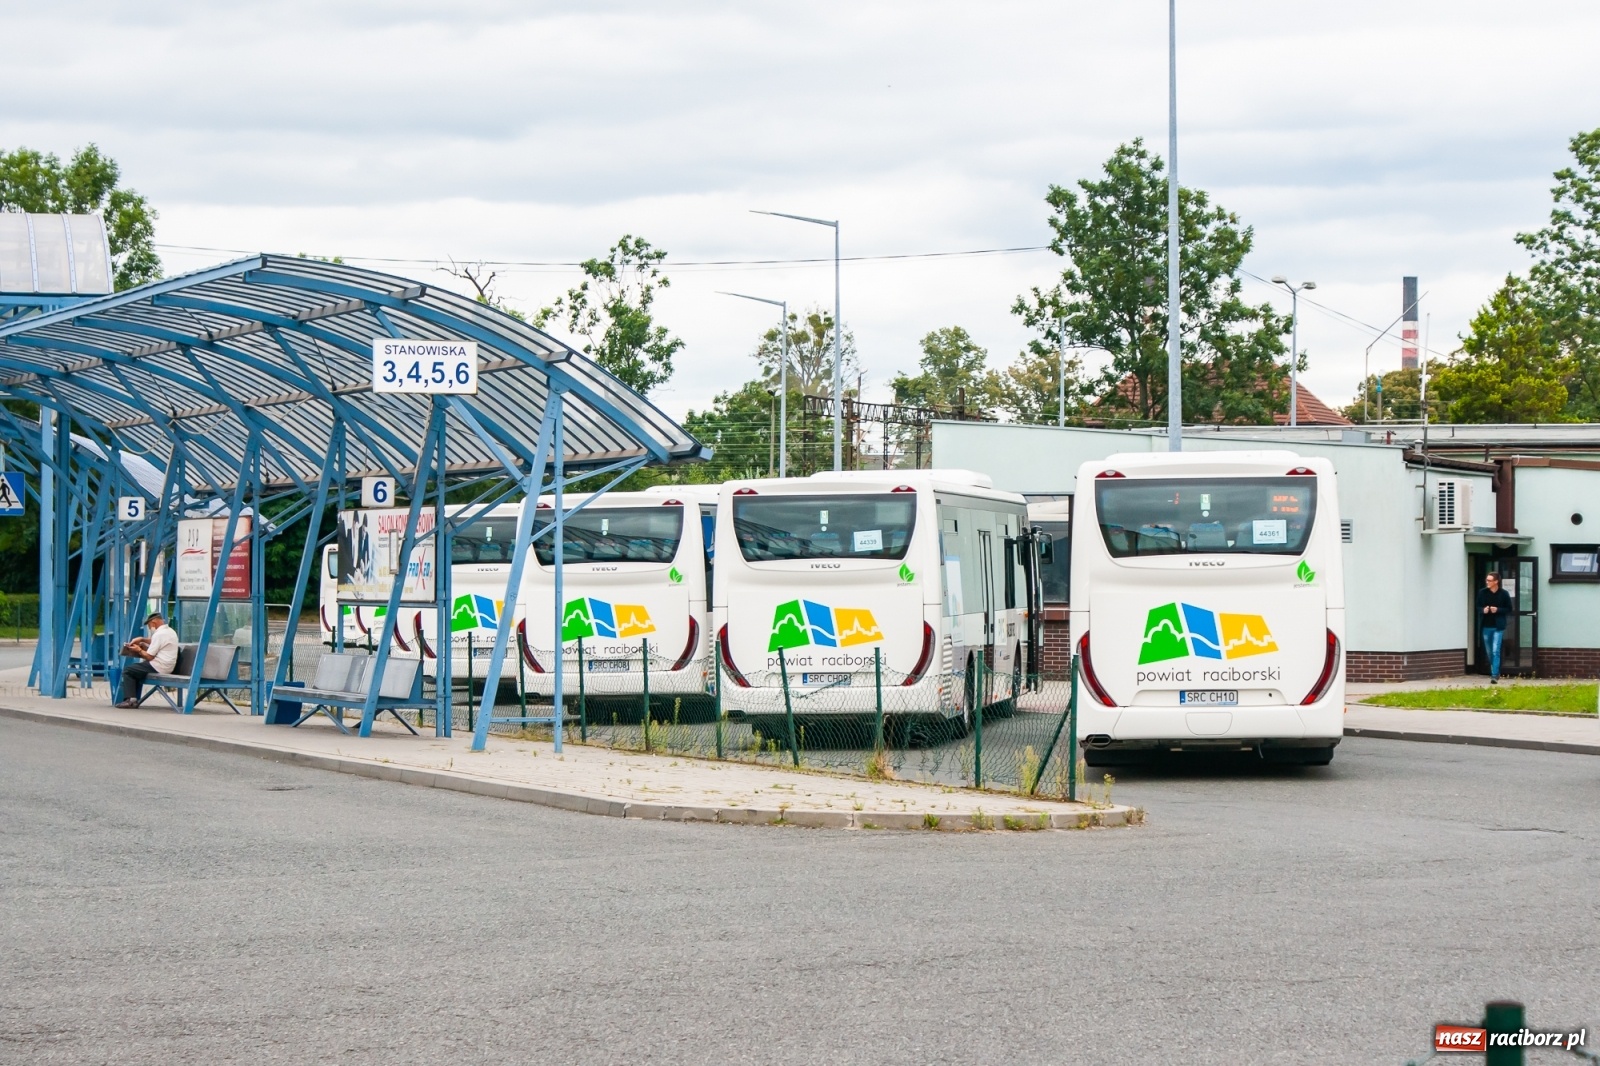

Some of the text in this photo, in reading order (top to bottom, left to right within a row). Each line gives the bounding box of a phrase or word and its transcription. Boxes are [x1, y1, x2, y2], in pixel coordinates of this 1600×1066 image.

[384, 344, 467, 357] STANOWISKA
[382, 360, 470, 388] 3,4,5,6
[373, 480, 388, 503] 6
[127, 500, 140, 518] 5
[810, 561, 841, 569] IVECO
[1189, 559, 1225, 567] IVECO
[604, 642, 659, 655] raciborki
[821, 653, 887, 666] raciborsi
[809, 674, 825, 683] SRC
[1136, 666, 1281, 686] powiat raciborski
[1187, 692, 1235, 702] SRC CH10
